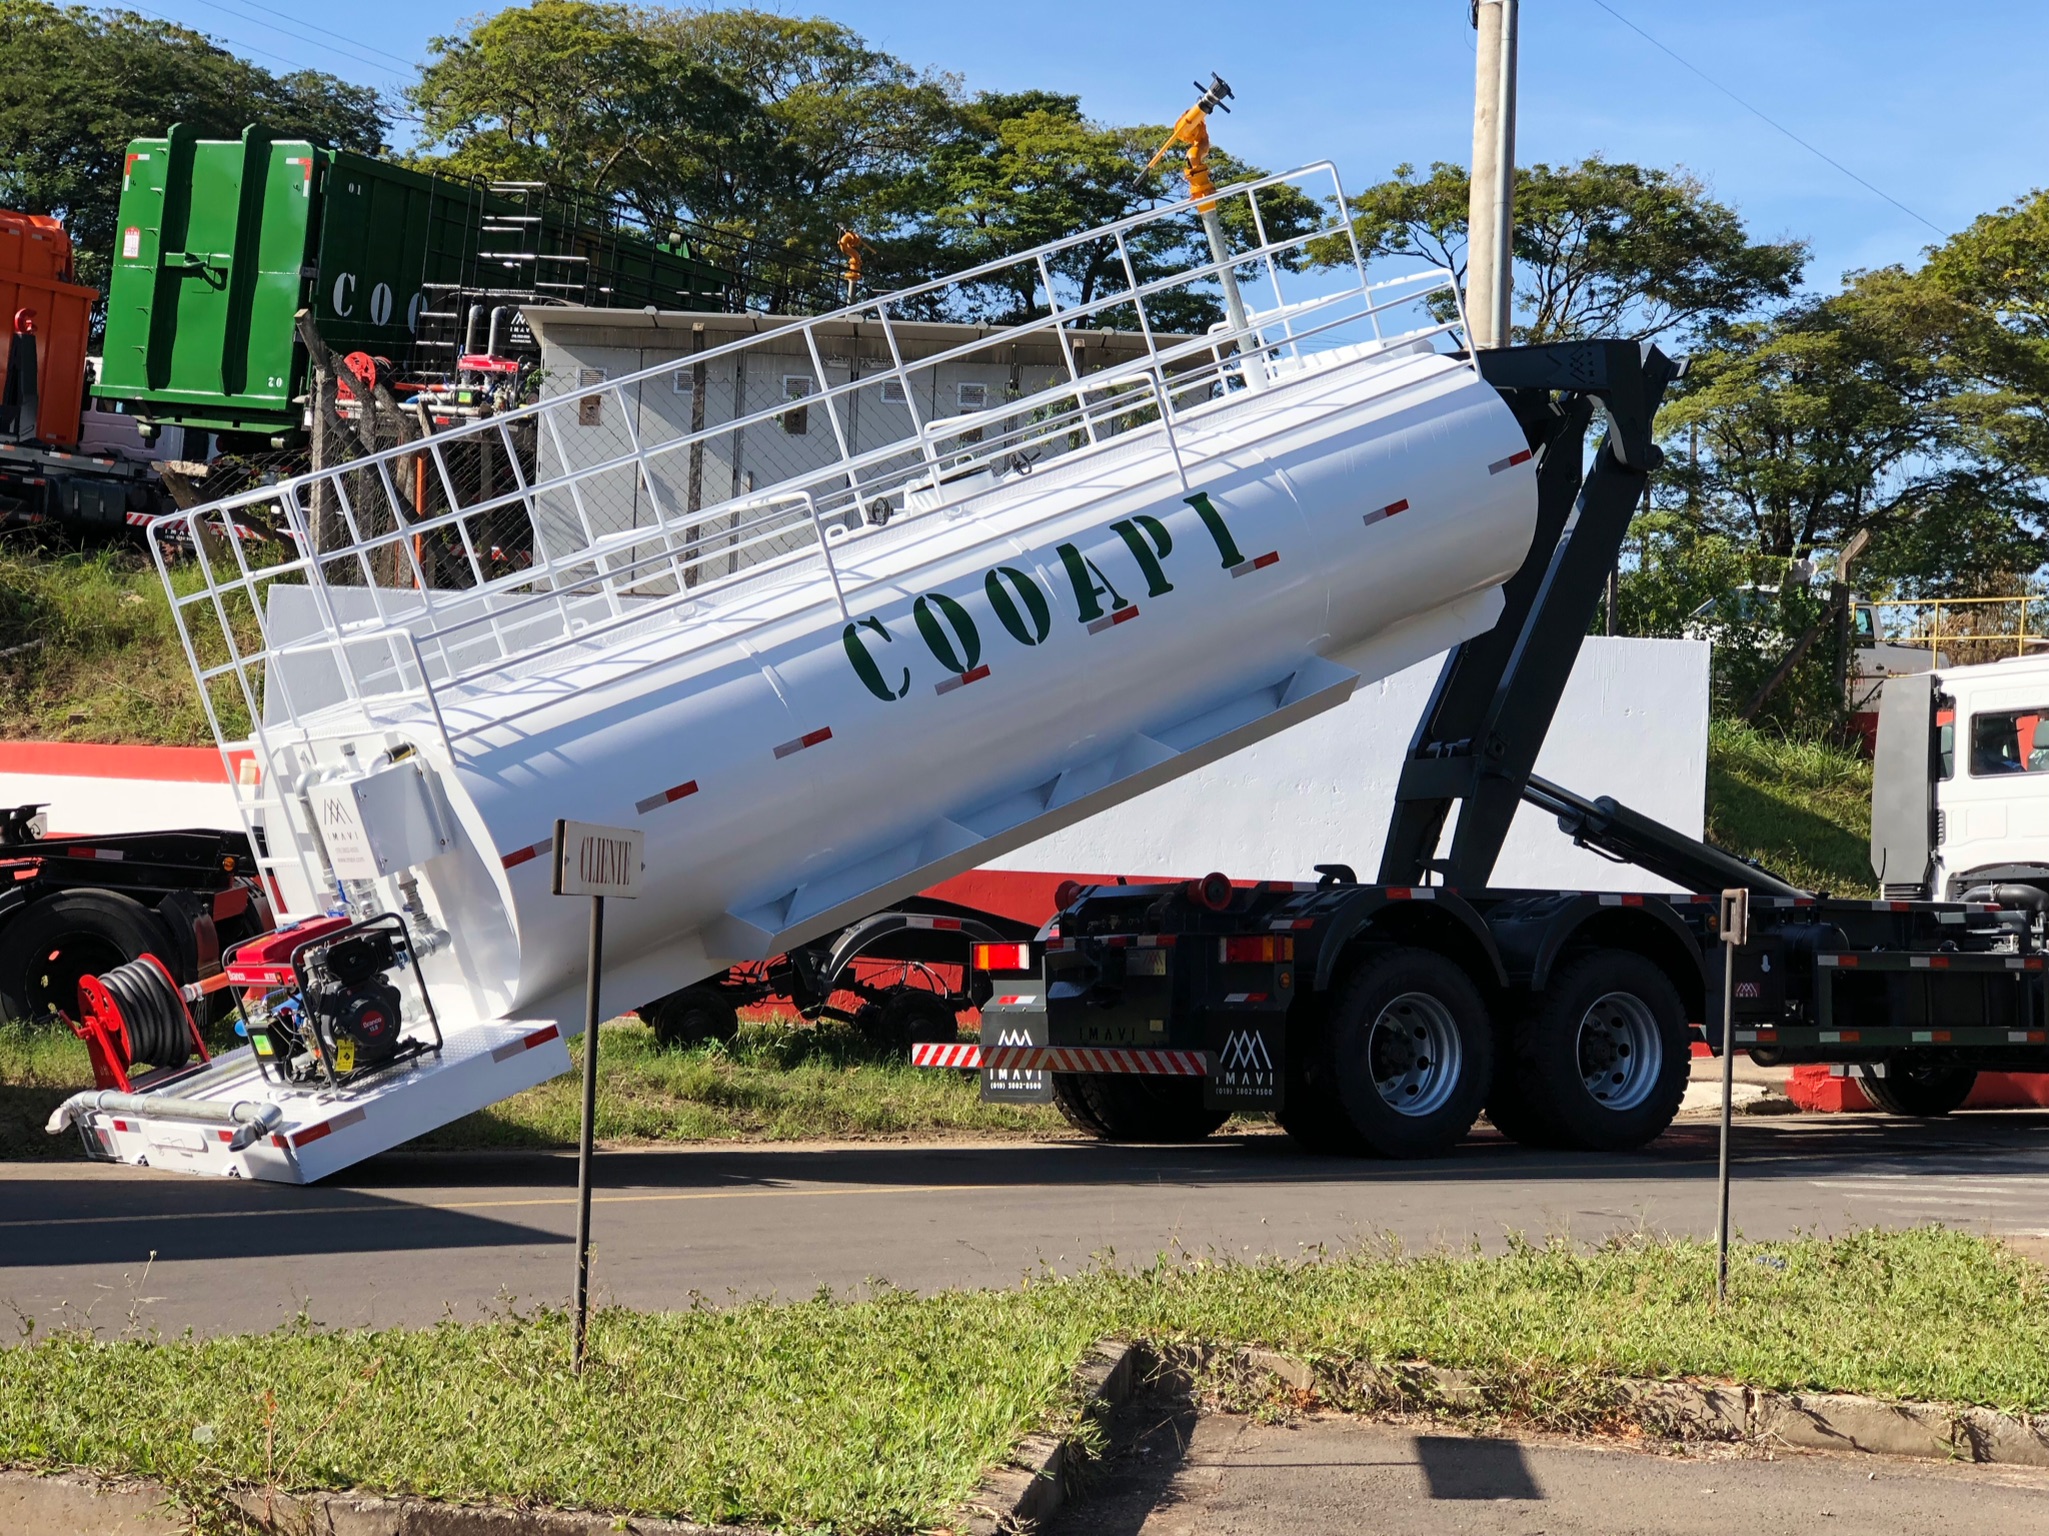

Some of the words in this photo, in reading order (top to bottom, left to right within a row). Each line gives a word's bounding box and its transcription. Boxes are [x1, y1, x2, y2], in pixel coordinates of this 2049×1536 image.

[349, 182, 361, 196] 01
[843, 491, 1245, 702] COOAPI
[327, 831, 358, 841] IMAVI
[580, 836, 631, 886] CLIENTE
[362, 1017, 381, 1028] Branco
[1080, 1027, 1135, 1041] IMAVI
[990, 1068, 1042, 1081] IMAVI
[1216, 1072, 1273, 1086] IMAVI
